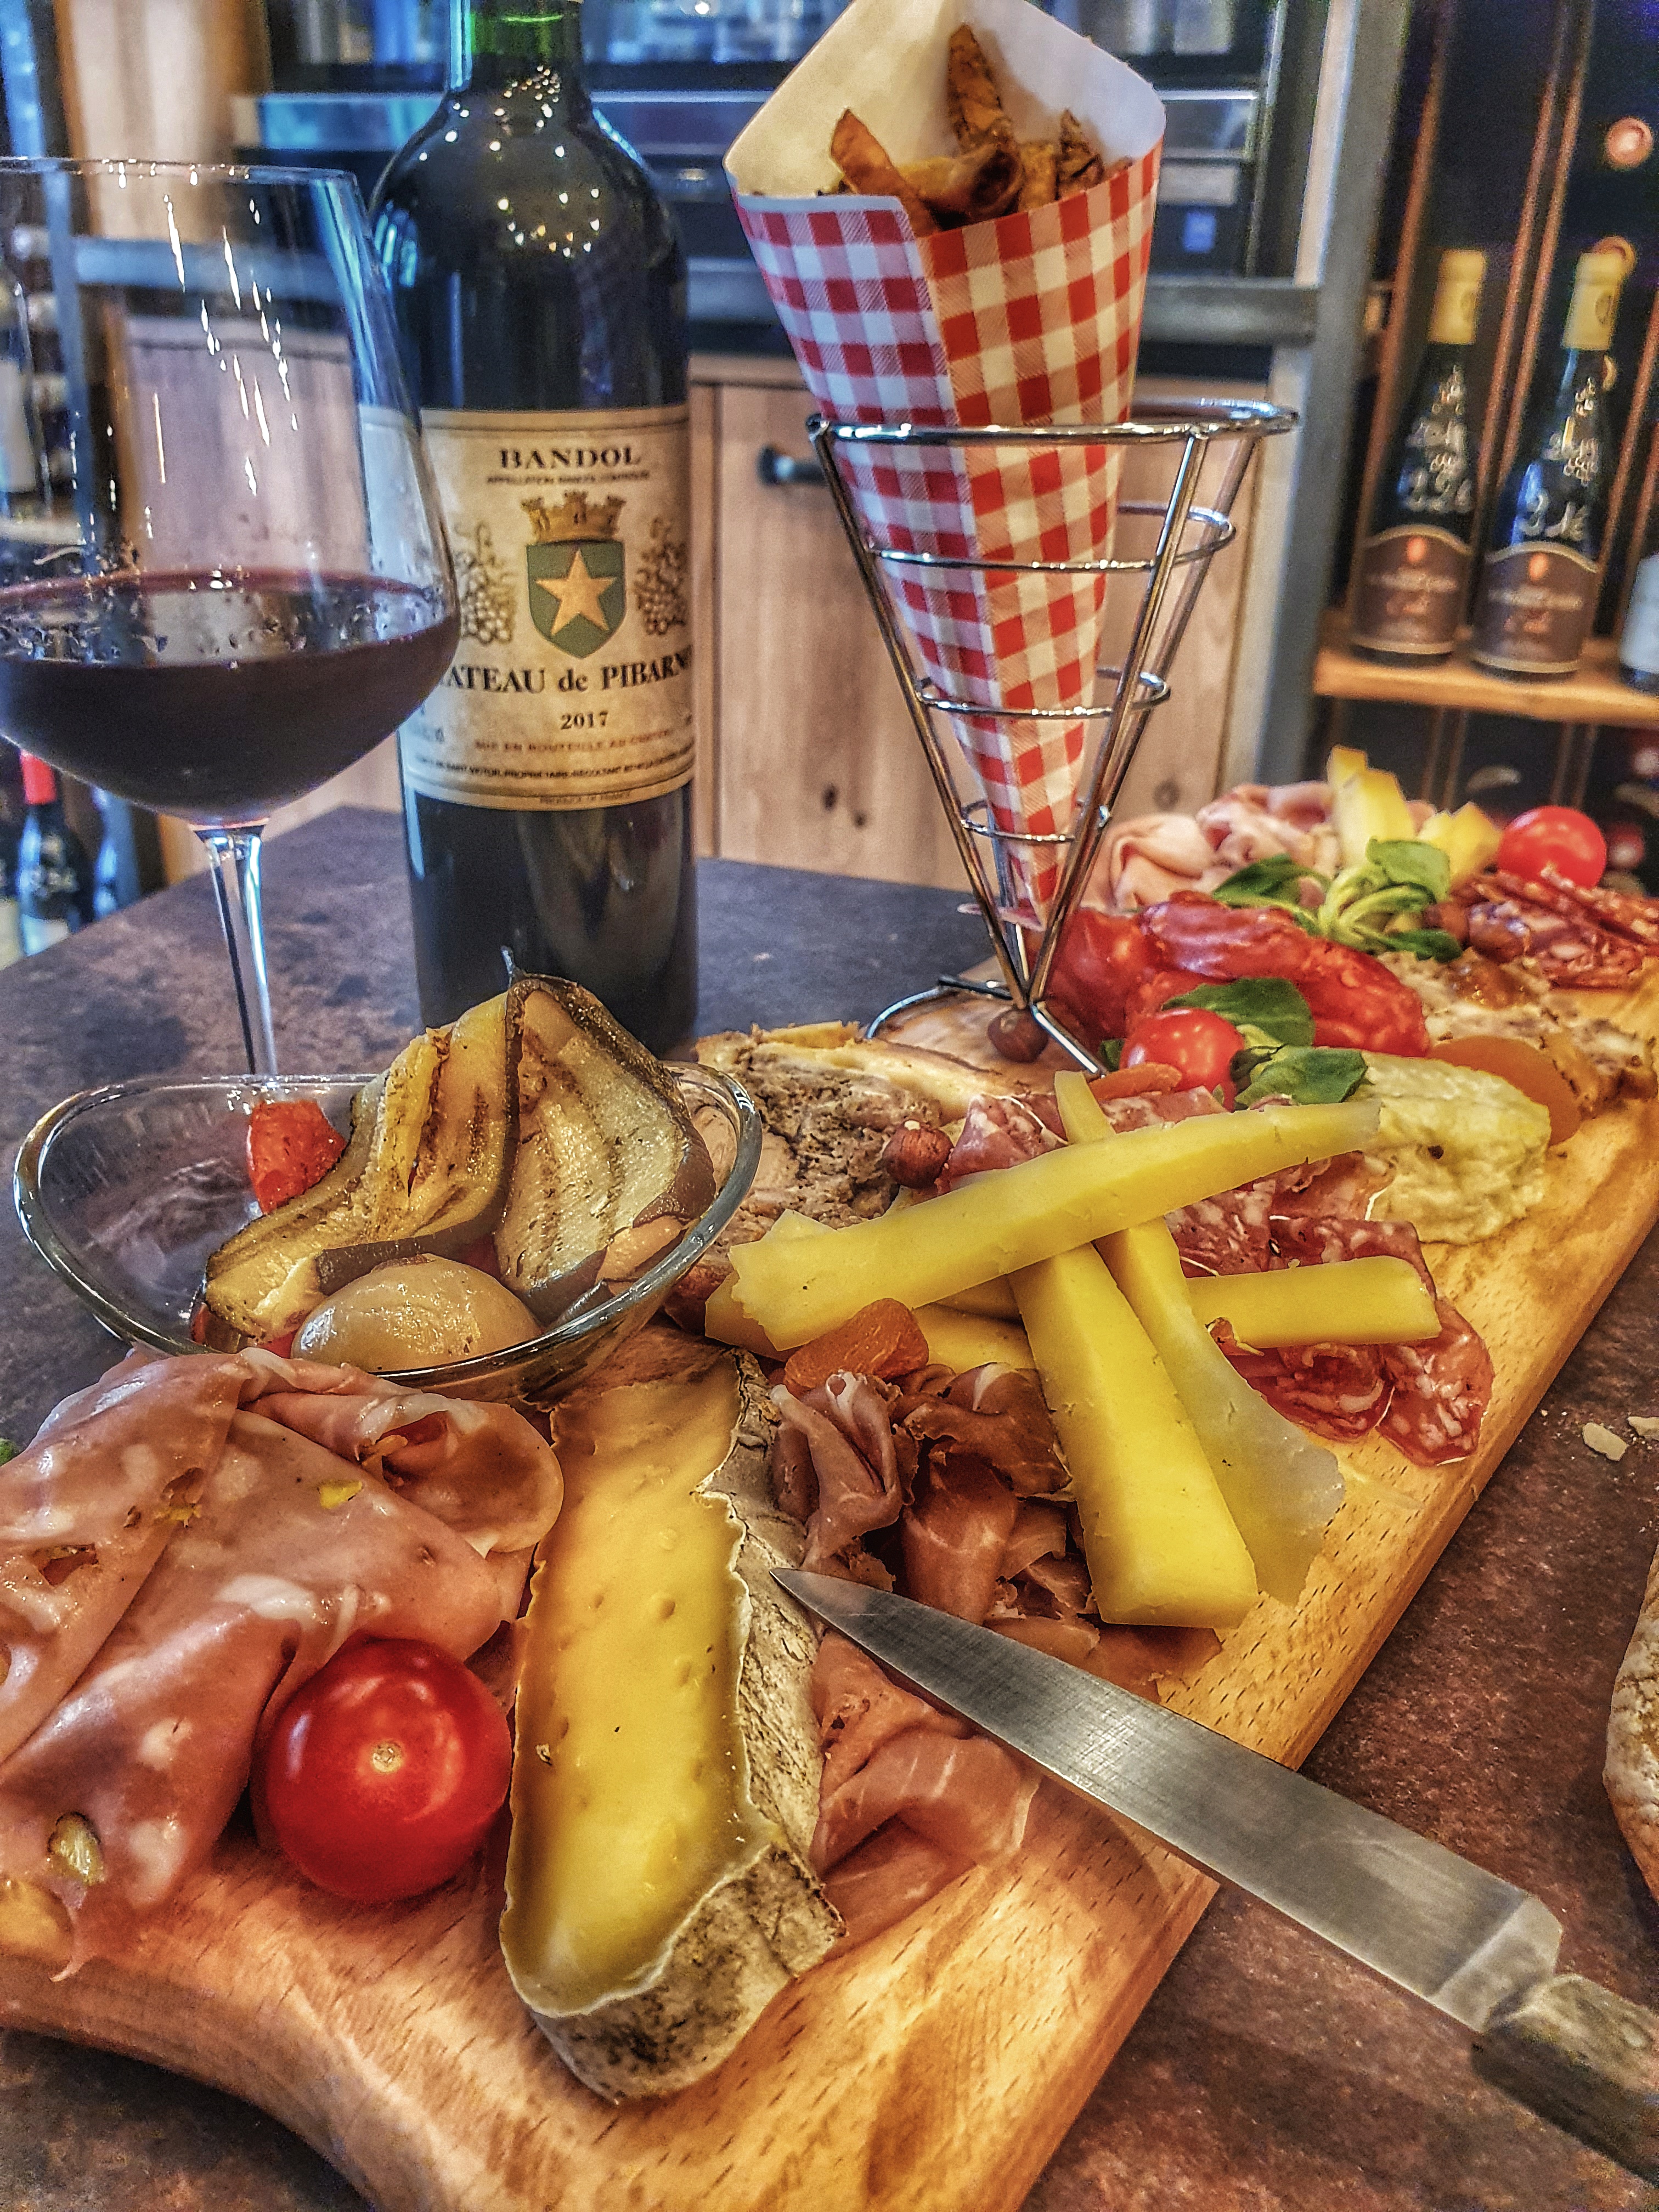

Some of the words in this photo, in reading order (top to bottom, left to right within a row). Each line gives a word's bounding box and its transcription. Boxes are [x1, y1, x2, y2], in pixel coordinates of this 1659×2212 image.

[499, 445, 642, 469] BANDOL
[445, 663, 544, 694] ATEAU
[557, 668, 588, 692] de
[560, 710, 608, 730] 2017
